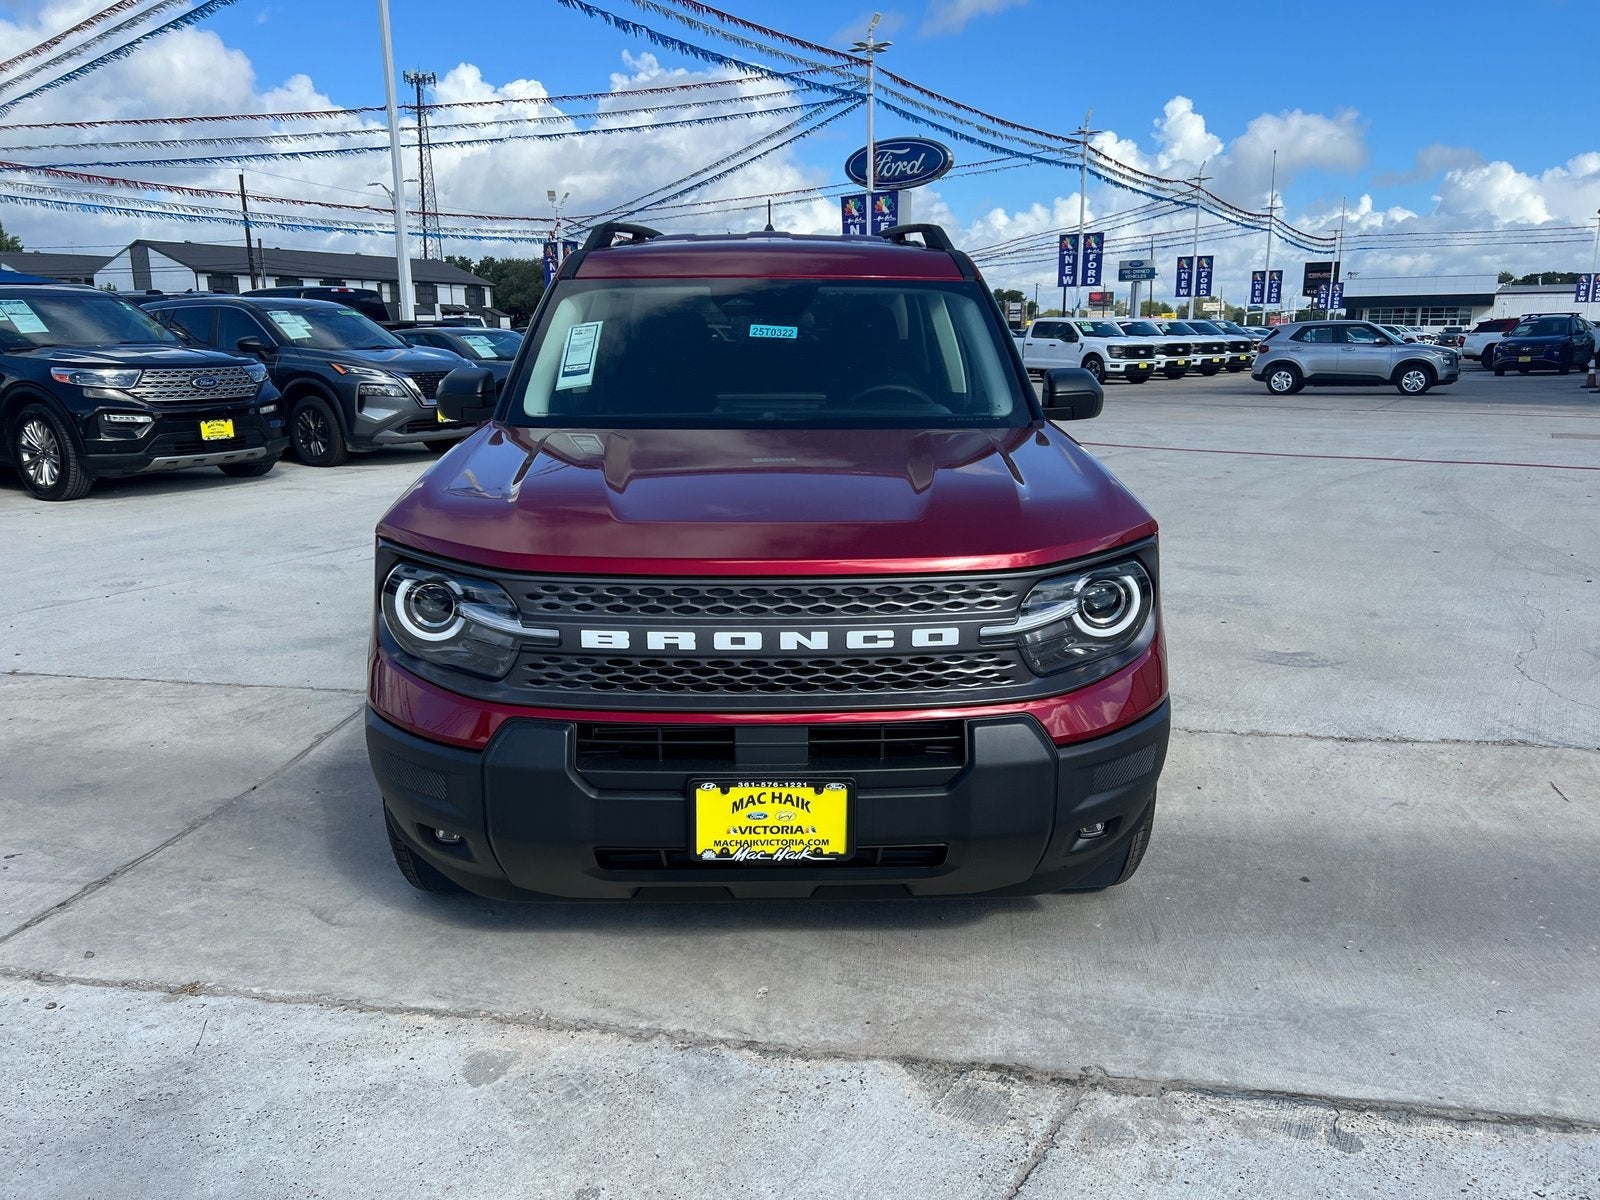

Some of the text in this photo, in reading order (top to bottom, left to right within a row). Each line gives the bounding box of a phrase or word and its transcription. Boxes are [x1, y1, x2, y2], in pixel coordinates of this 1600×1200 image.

[867, 147, 925, 178] Ford
[1062, 255, 1074, 285] NEW
[1087, 253, 1097, 284] FORD
[1179, 272, 1188, 296] NEW
[1200, 271, 1208, 295] FORD
[1253, 283, 1261, 303] NEW
[1578, 284, 1586, 302] NEW
[752, 327, 794, 337] 25T0322
[581, 627, 959, 650] BRONCO
[731, 791, 811, 814] MAC HAIK
[738, 825, 805, 835] VICTORIA
[713, 838, 830, 848] MACHAIKVICTORIA.COM
[732, 845, 815, 862] Mac Haik
